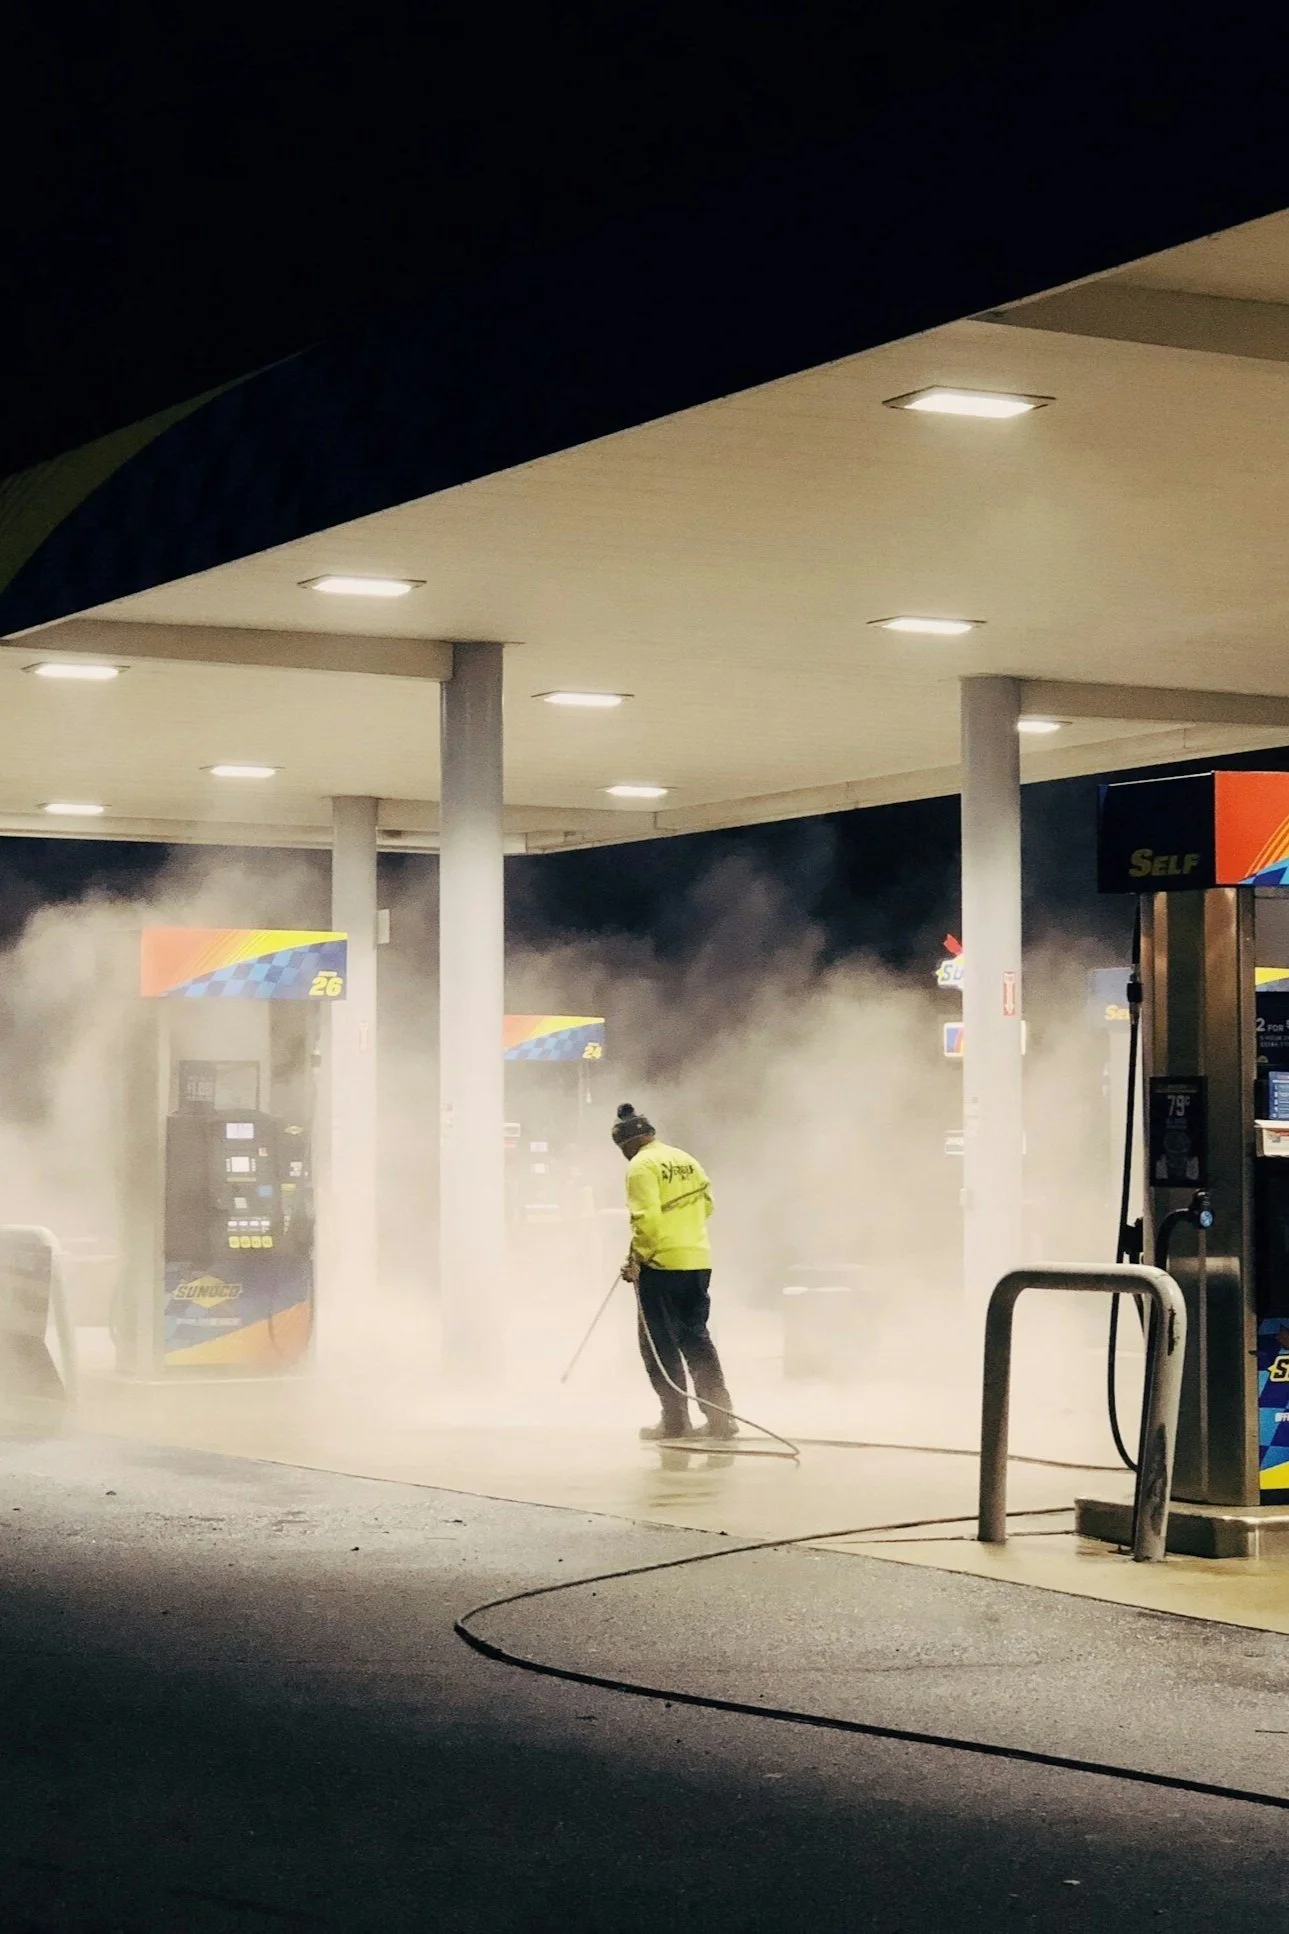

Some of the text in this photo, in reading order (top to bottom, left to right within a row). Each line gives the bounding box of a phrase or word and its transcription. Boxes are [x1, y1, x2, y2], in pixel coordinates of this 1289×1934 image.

[1128, 849, 1200, 877] SELF
[309, 976, 343, 997] 26
[1256, 1017, 1266, 1032] 2
[1267, 1024, 1284, 1032] FOR
[175, 1285, 241, 1298] SUNOCO
